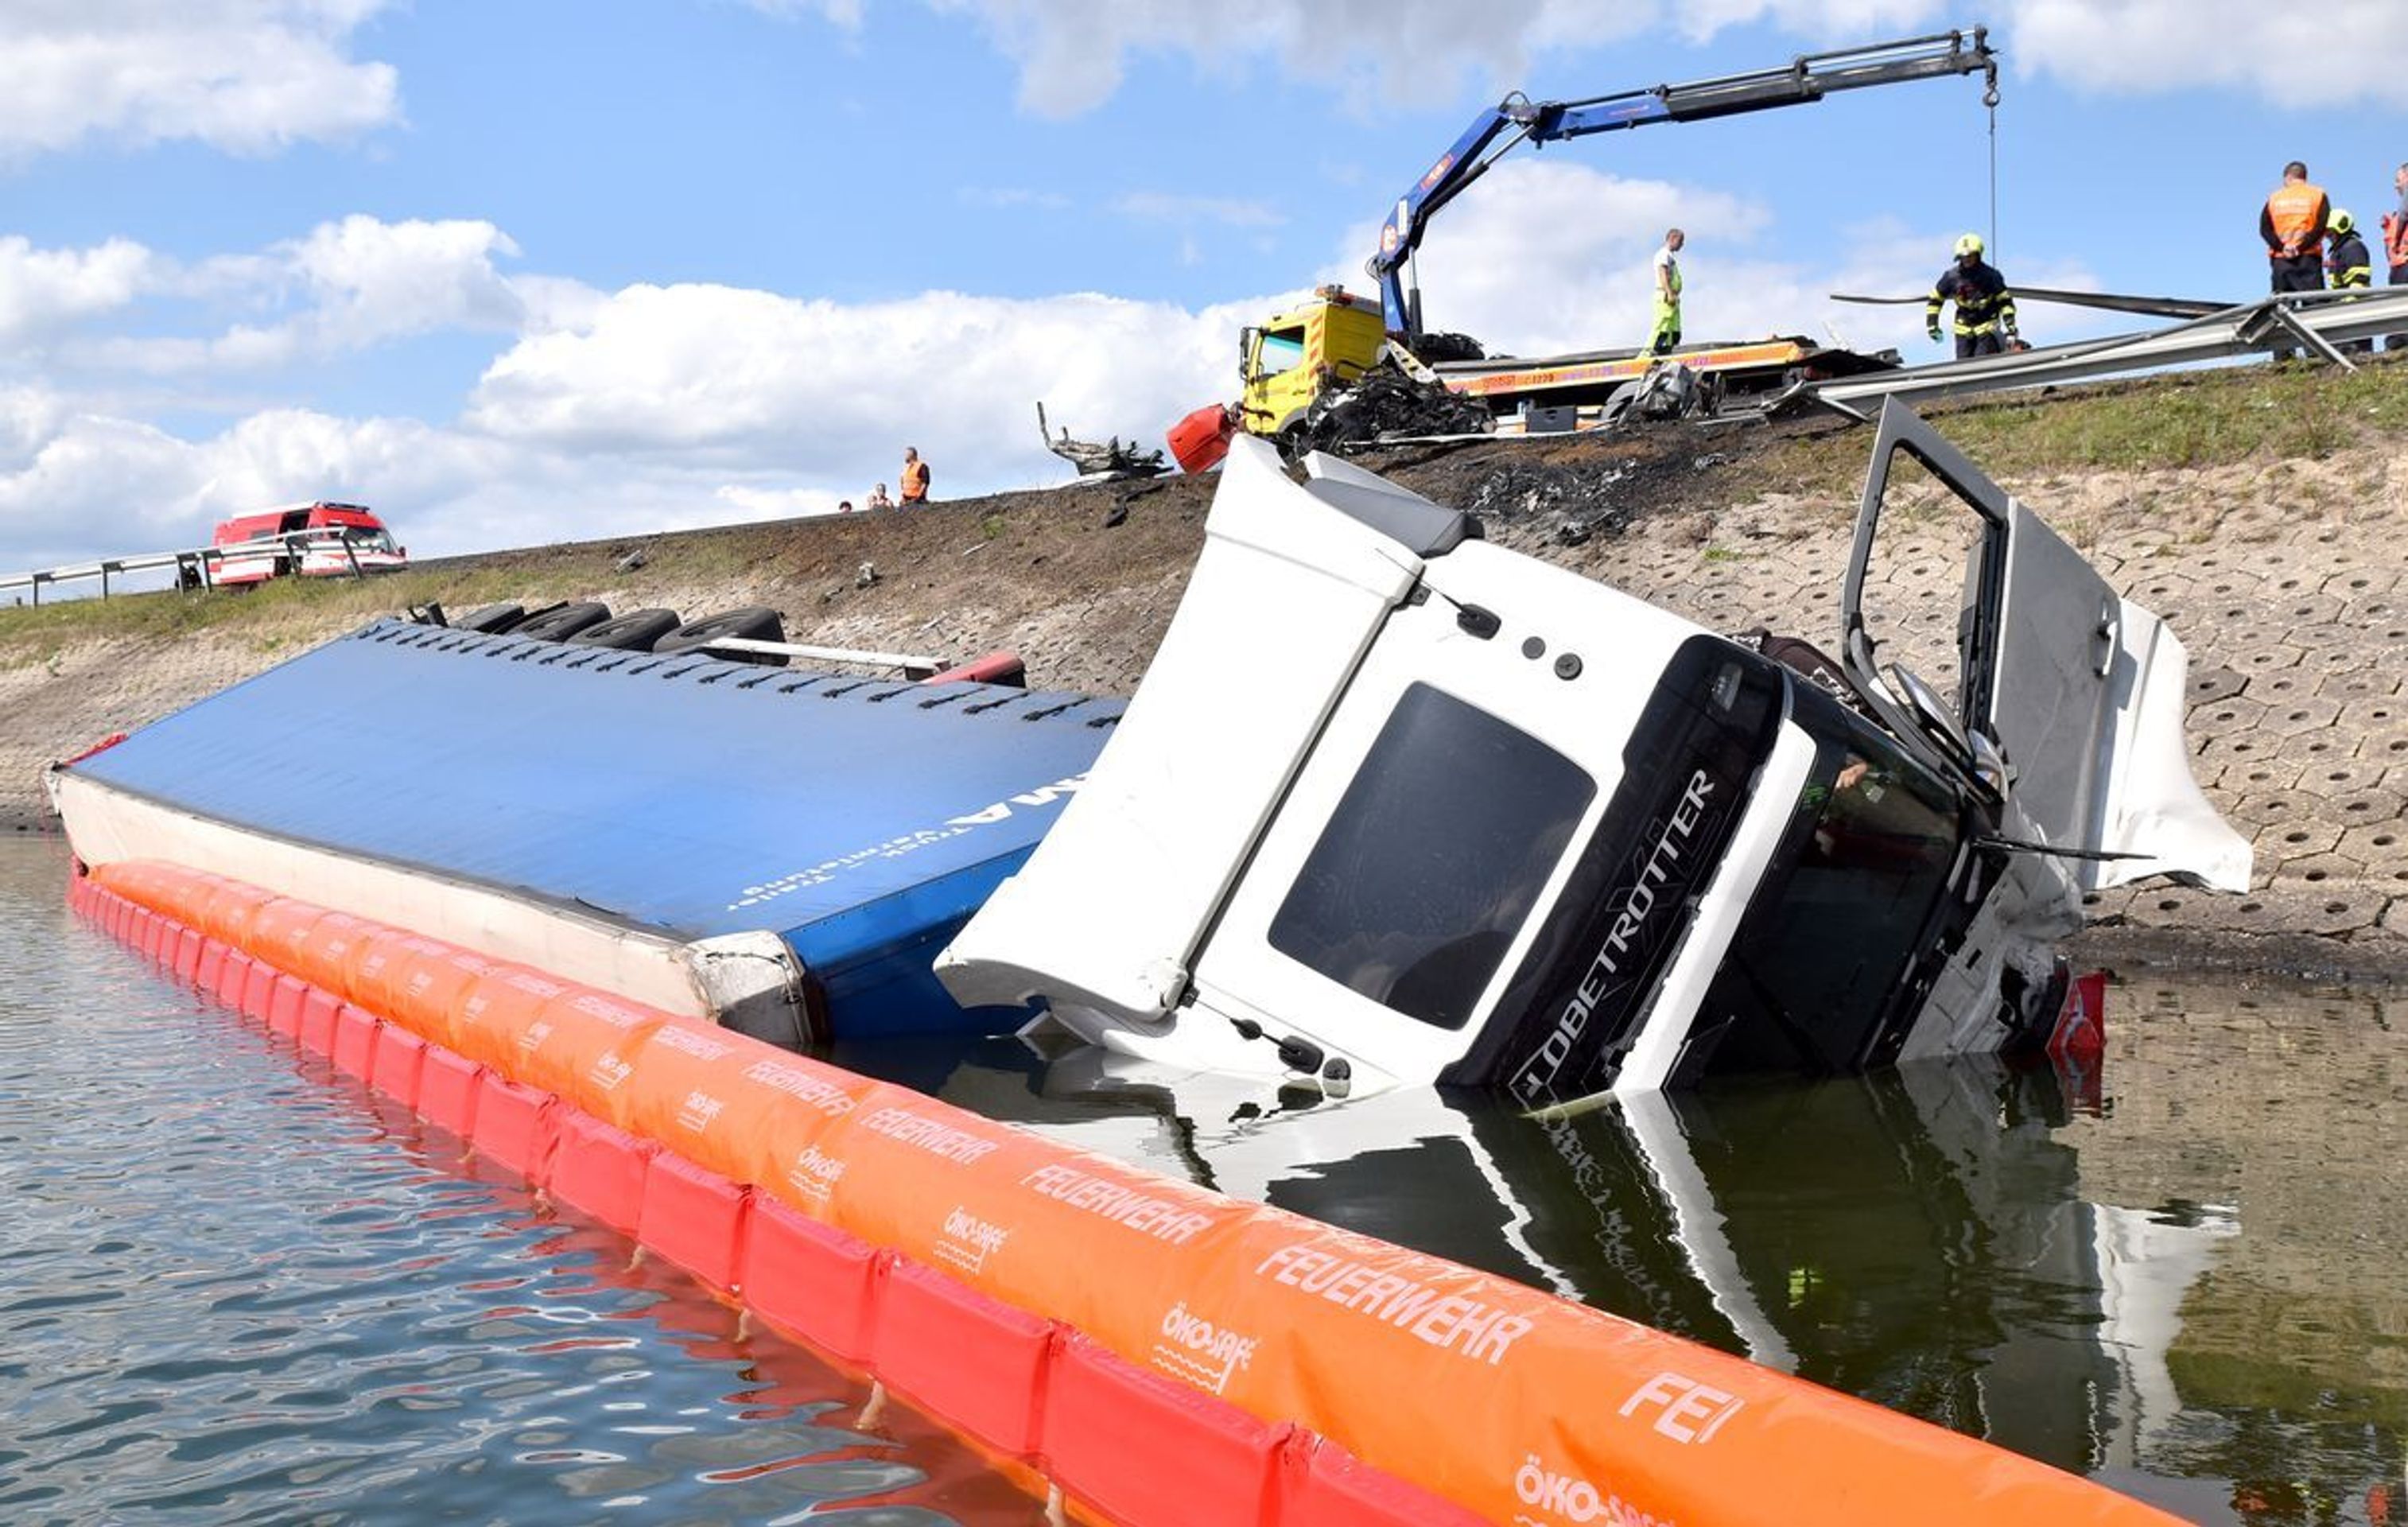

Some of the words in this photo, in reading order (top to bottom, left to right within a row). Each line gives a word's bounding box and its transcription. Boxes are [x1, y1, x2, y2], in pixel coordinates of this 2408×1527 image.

[858, 1106, 1000, 1165] FEUERWEHR
[1019, 1164, 1216, 1246] FEUERWEHR
[1255, 1242, 1536, 1366] FEUERWEHR
